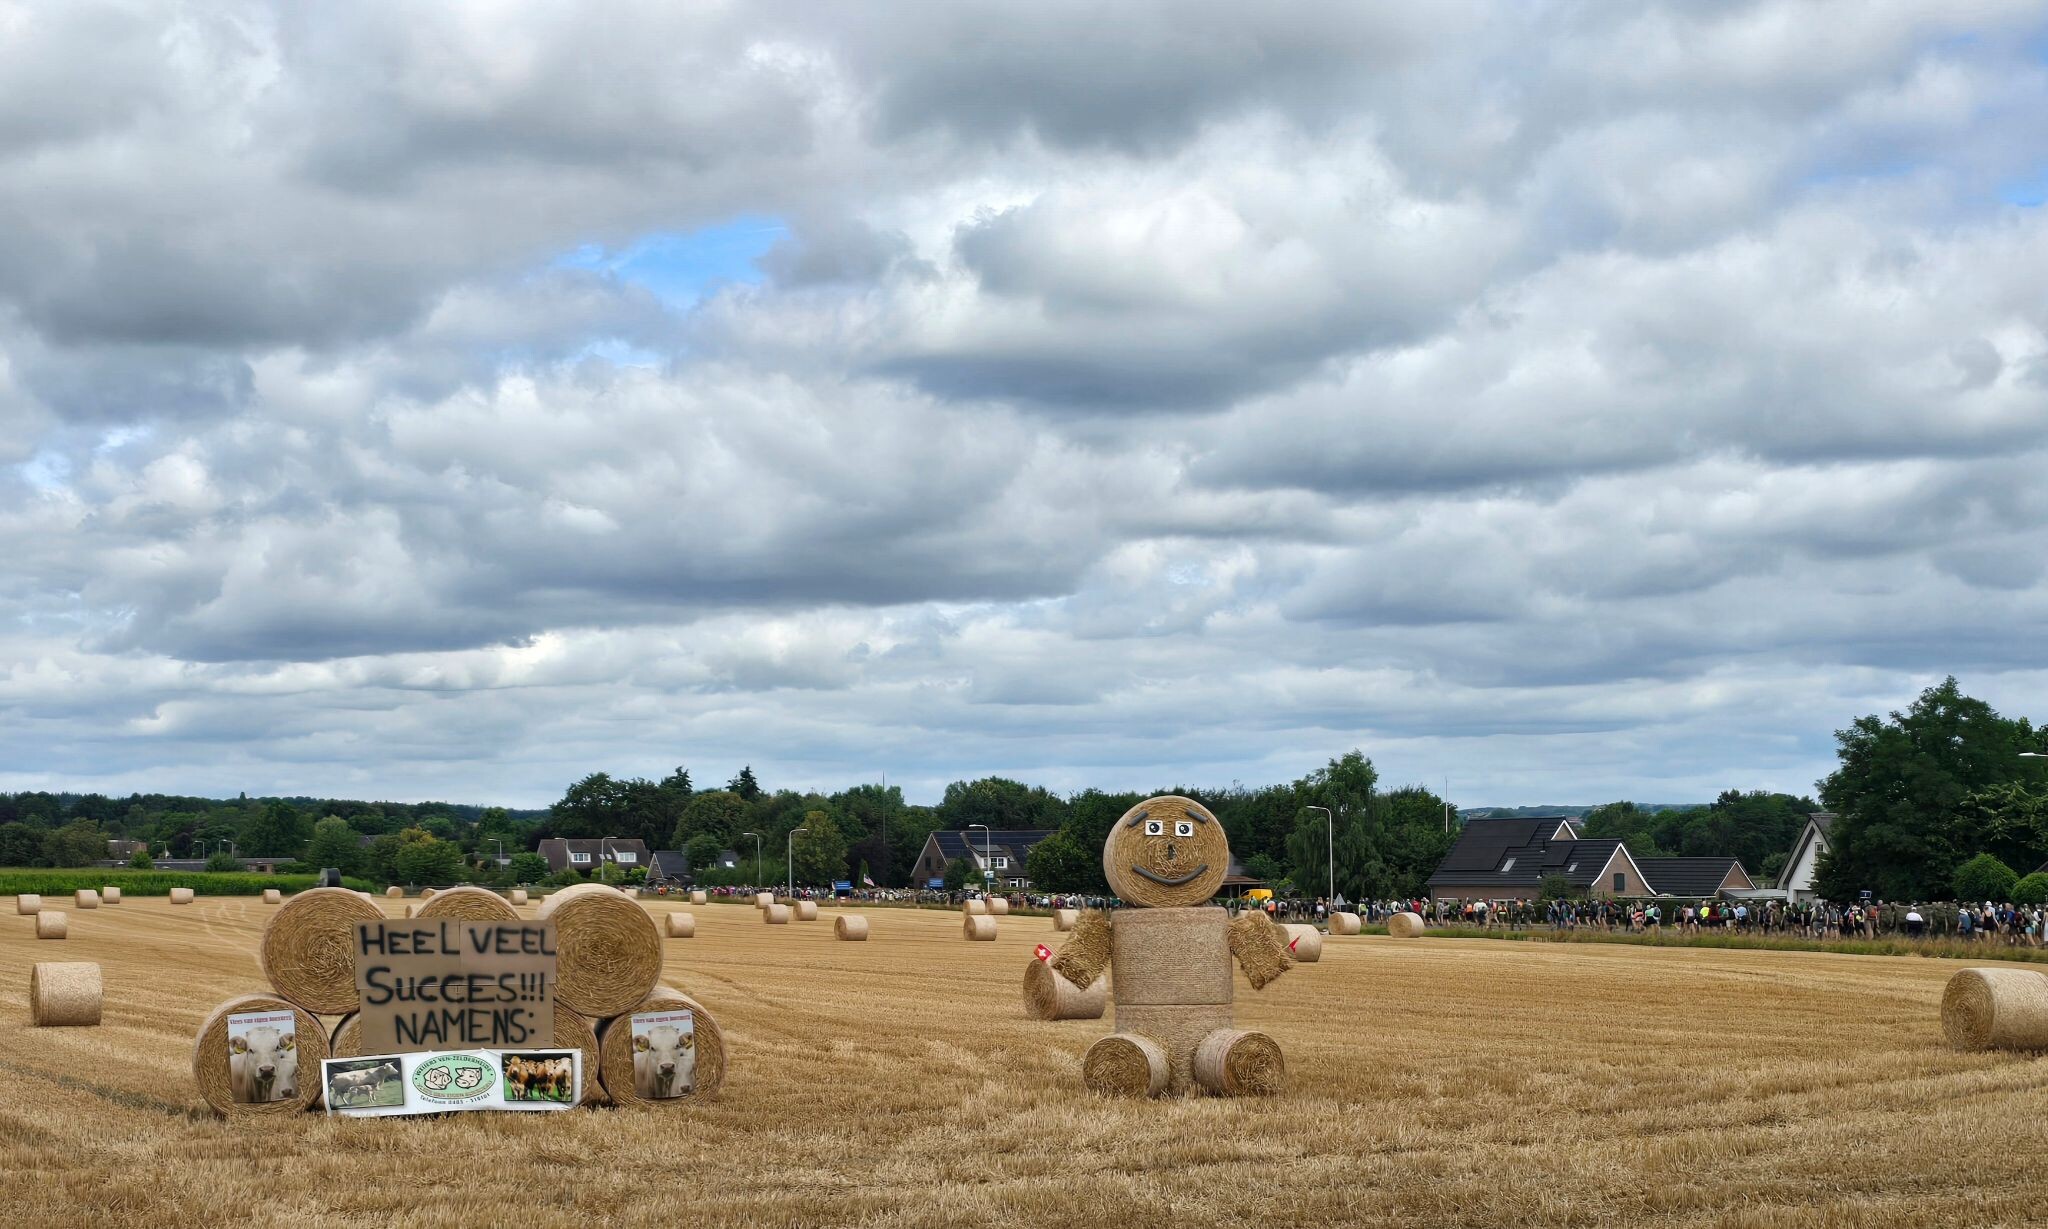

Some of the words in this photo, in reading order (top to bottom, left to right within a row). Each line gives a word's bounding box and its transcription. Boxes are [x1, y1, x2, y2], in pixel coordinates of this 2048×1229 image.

[360, 922, 460, 955] HEEL
[468, 927, 556, 955] VEEL
[395, 1007, 536, 1045] NAMENS:
